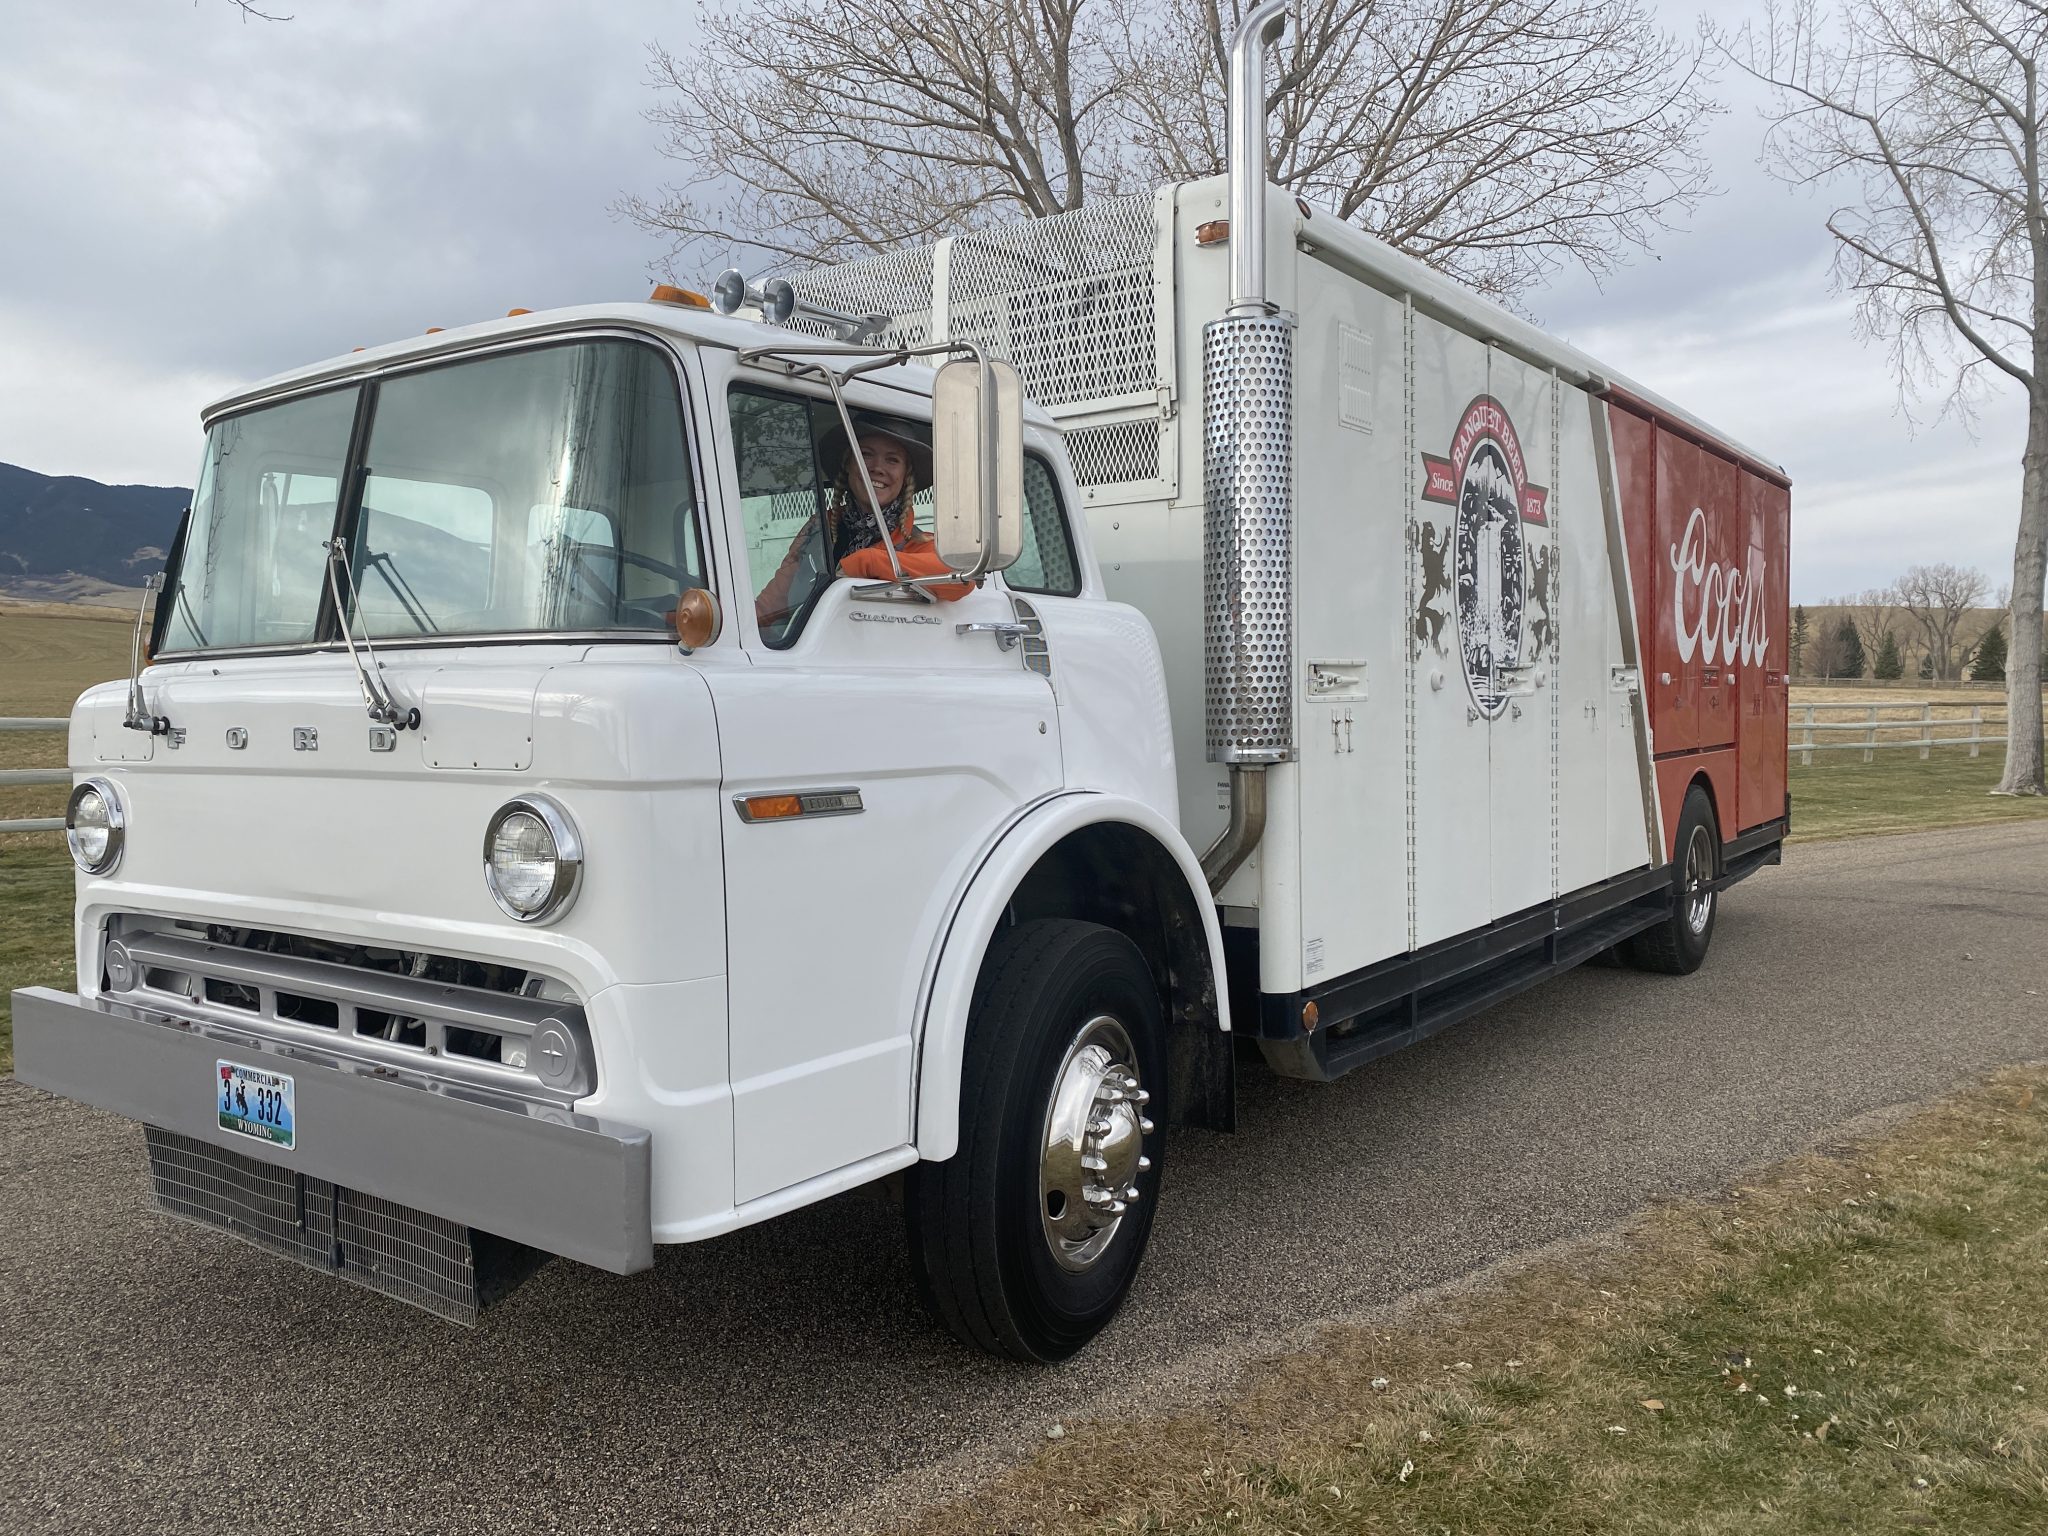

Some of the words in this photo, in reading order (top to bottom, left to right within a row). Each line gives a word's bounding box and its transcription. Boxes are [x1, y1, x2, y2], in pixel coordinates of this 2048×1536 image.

[1454, 405, 1502, 472] BANQUET
[1501, 421, 1525, 491] BEER
[1432, 472, 1454, 492] Since
[1526, 497, 1541, 515] 1873
[1670, 507, 1770, 668] Coors
[848, 610, 911, 624] Custom
[167, 726, 397, 752] FORD
[235, 1068, 276, 1087] COMMERCIAL
[223, 1079, 231, 1111] 3
[257, 1087, 282, 1126] 332
[237, 1118, 272, 1139] WYOMING
